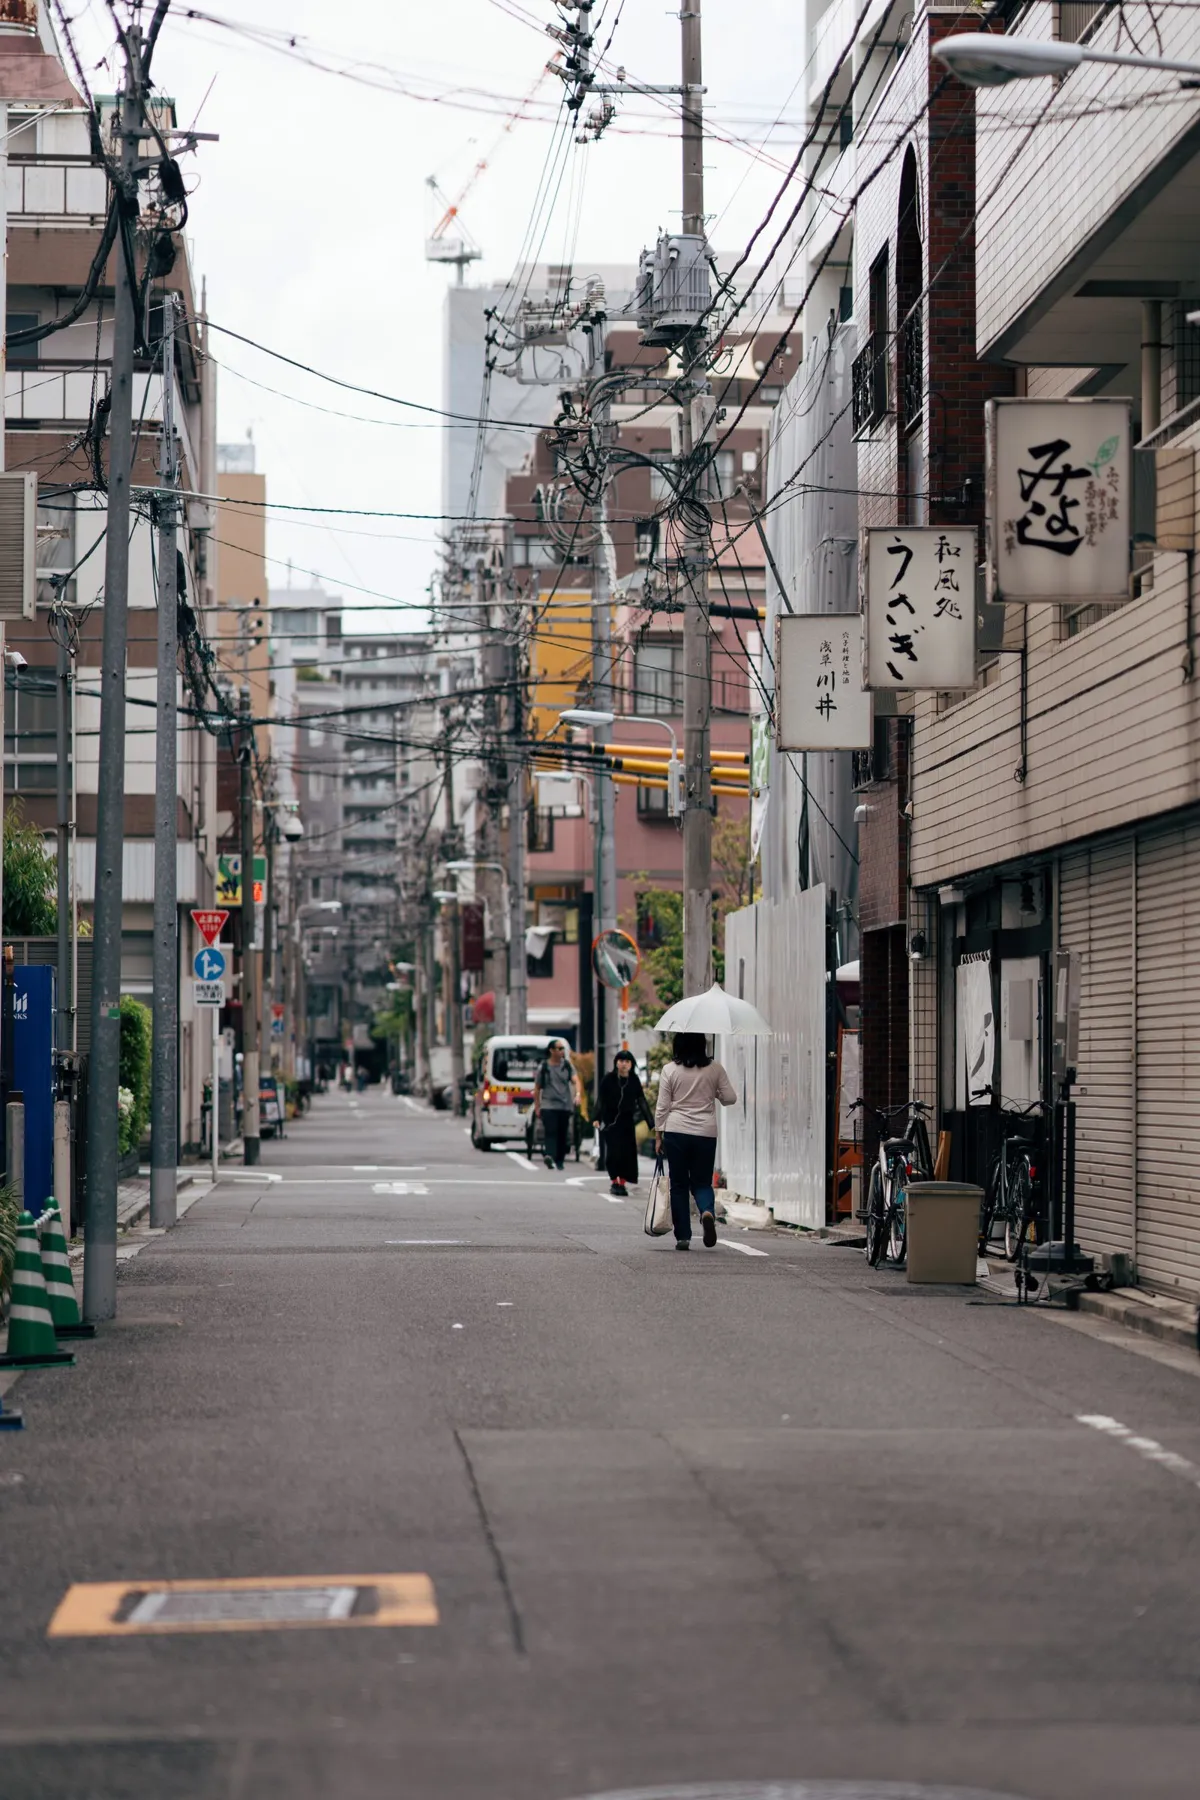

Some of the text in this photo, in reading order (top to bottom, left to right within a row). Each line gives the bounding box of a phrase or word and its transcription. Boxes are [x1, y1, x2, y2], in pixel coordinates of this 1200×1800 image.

[885, 536, 925, 680] うさぎ
[933, 535, 962, 620] 和風処
[815, 640, 837, 722] 浅草 川井
[842, 631, 850, 684] 穴子料理と地酒
[200, 915, 222, 923] 止まれ
